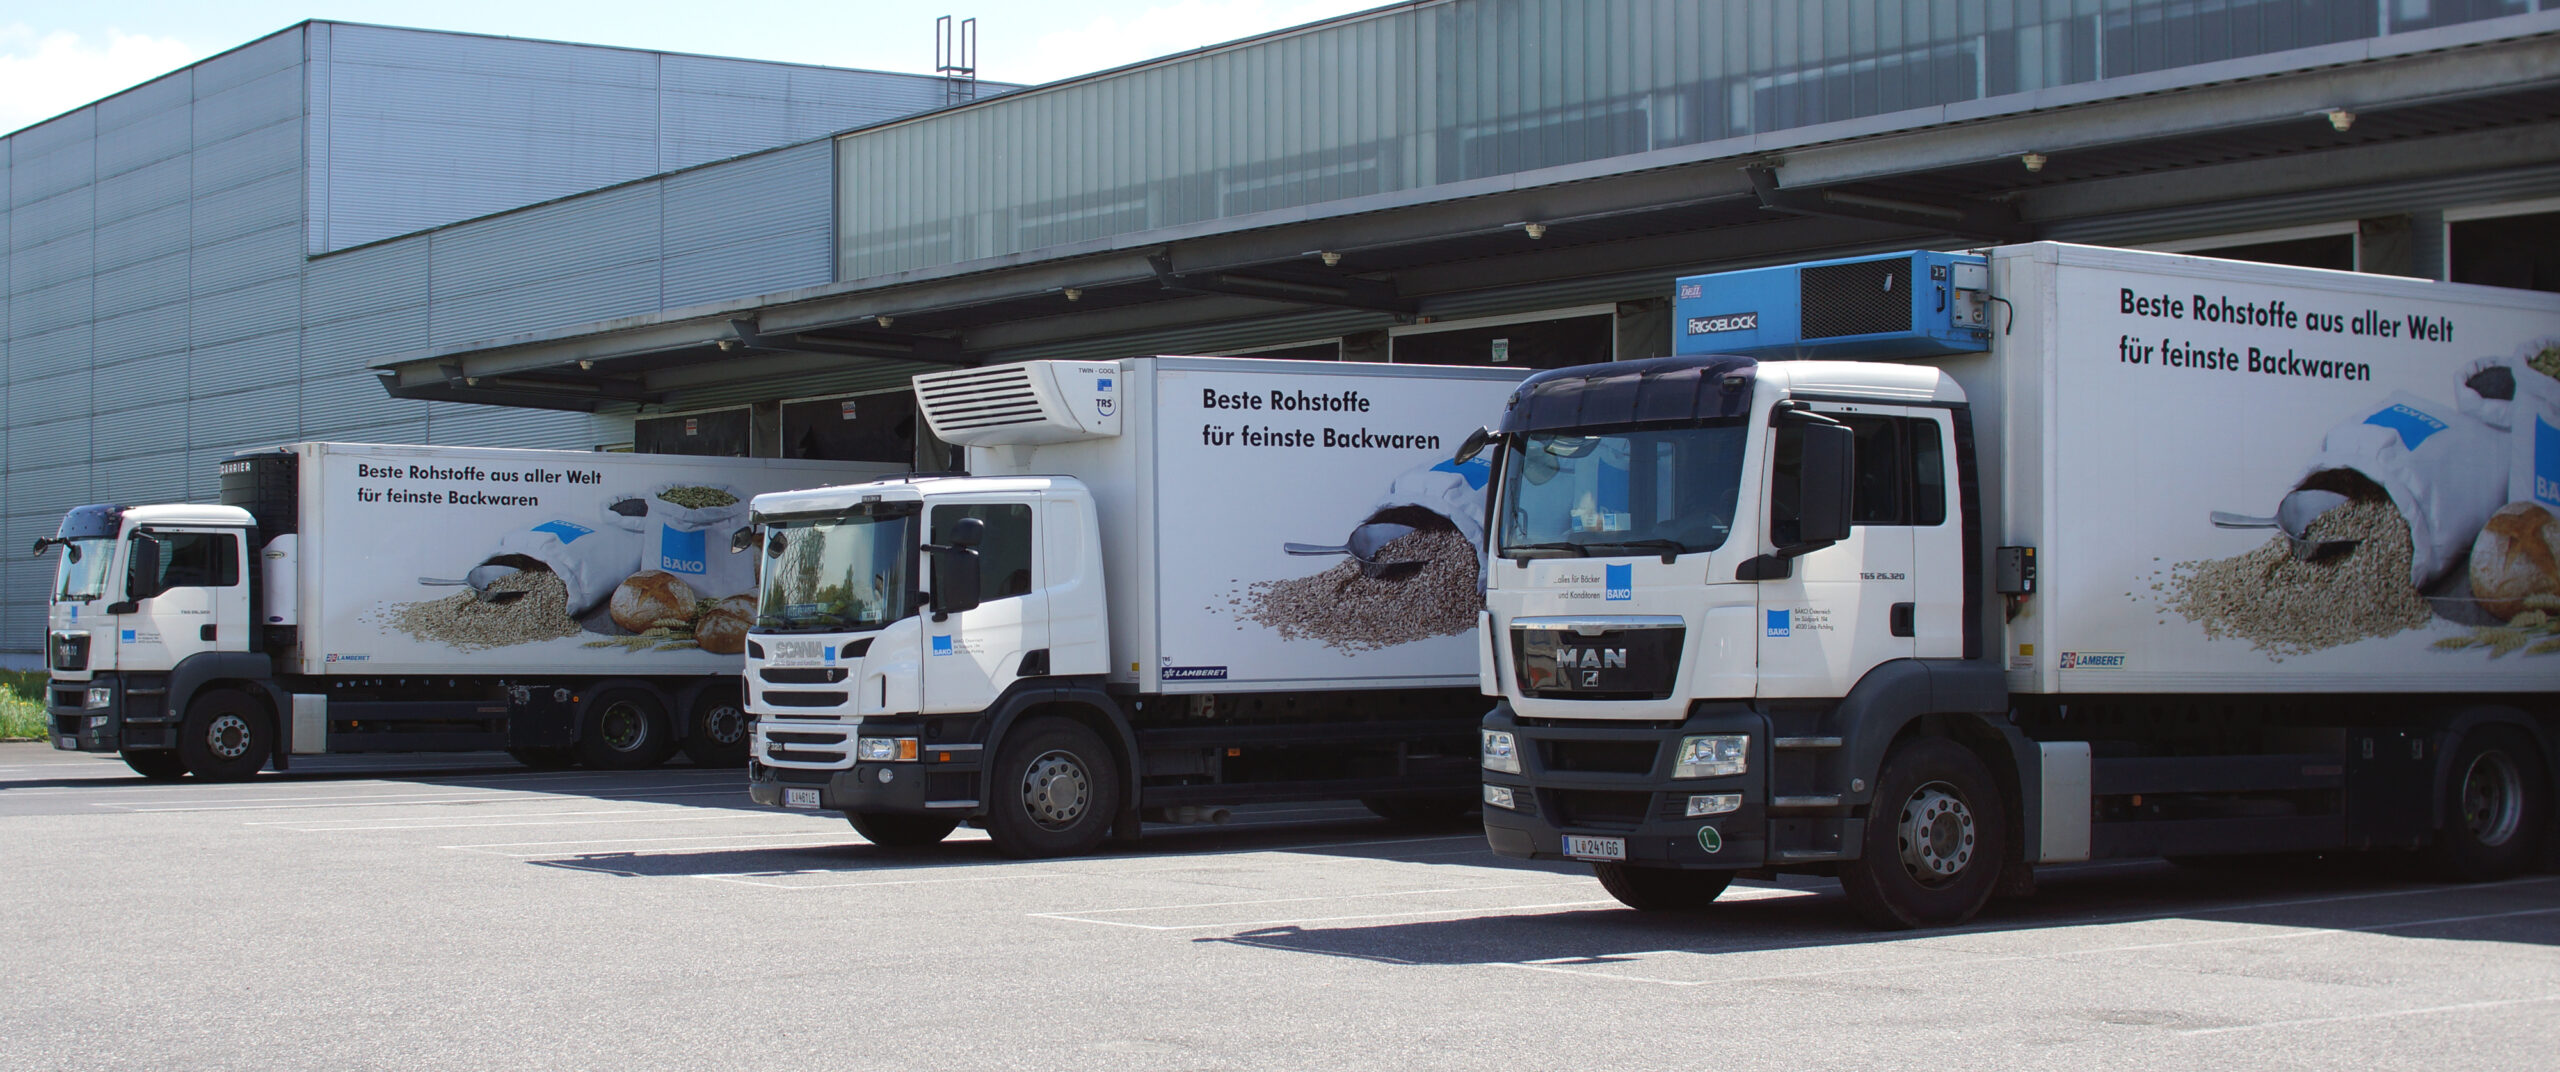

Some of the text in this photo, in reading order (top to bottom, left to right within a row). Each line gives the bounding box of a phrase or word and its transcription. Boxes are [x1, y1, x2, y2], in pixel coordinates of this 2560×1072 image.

[2120, 287, 2454, 343] Beste Rohstoffe aus aller Welt
[1688, 315, 1757, 335] FRIGOBLOCK
[2119, 335, 2371, 381] für feinste Backwaren
[1096, 398, 1113, 408] TRS
[1203, 388, 1371, 412] Beste Rohstoffe
[1202, 424, 1440, 450] für feinste Backwaren
[220, 461, 251, 475] CARRIER
[358, 463, 602, 485] Beste Rohstoffe aus aller Welt
[357, 487, 539, 507] für feinste Backwaren
[1571, 574, 1579, 583] für
[1580, 574, 1600, 584] Bäcker
[1876, 572, 1905, 580] 26.320
[1558, 589, 1600, 599] und Konditoren
[775, 641, 825, 659] SCANIA
[1556, 648, 1627, 668] MAN
[2075, 655, 2125, 666] LAMBERET
[1175, 669, 1227, 677] LAMBERET
[1703, 831, 1717, 849] L
